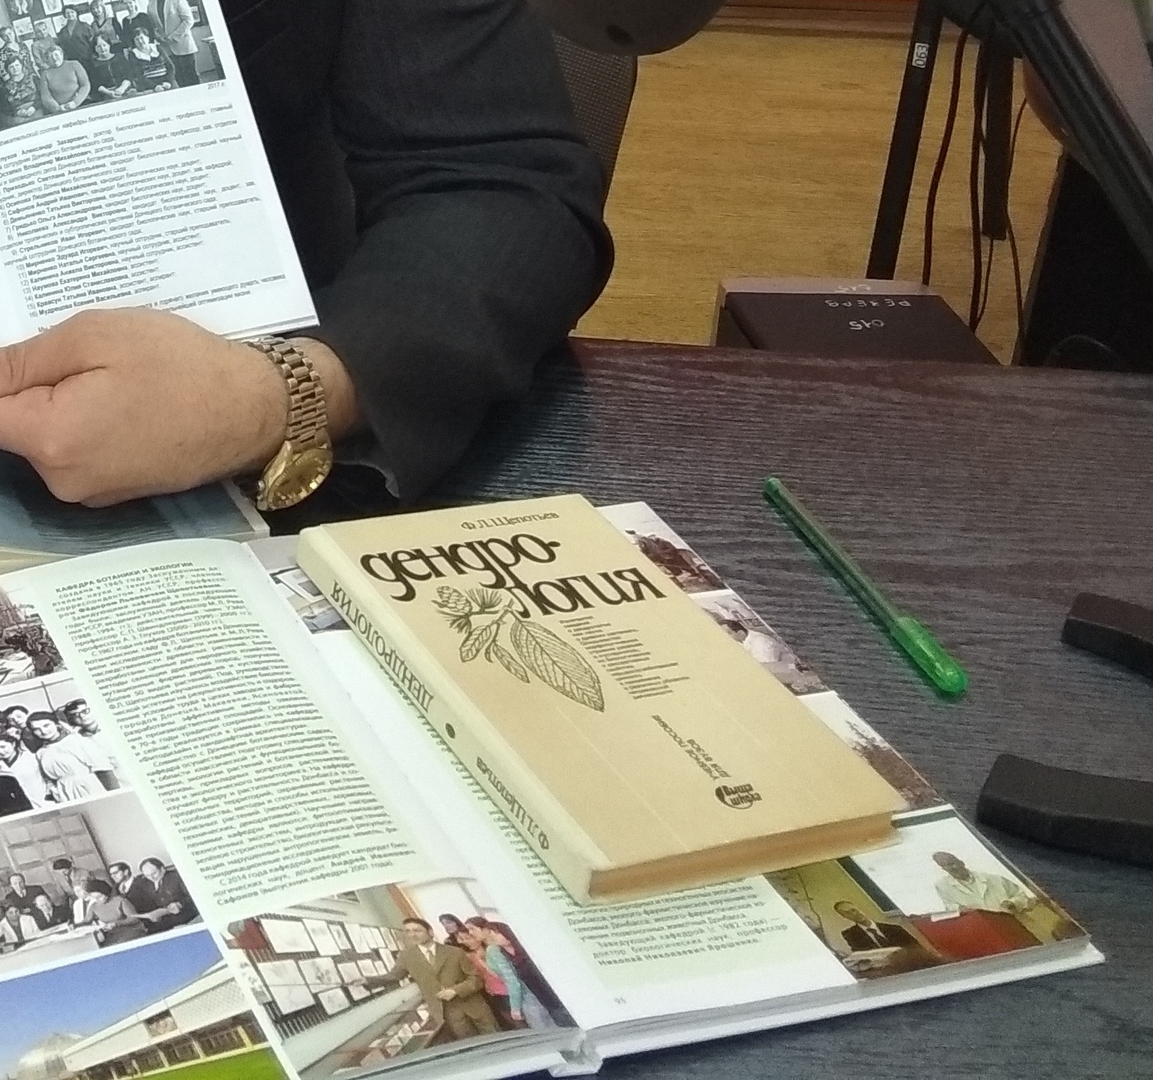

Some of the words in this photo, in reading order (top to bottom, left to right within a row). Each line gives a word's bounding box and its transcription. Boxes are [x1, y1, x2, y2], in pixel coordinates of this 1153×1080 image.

[914, 45, 927, 67] 063
[22, 143, 53, 155] Александр
[55, 580, 95, 593] КАФЕДРА
[96, 570, 141, 583] БОТАНИКИ
[150, 562, 193, 572] ЭКОЛОГИИ
[104, 580, 123, 588] 1965
[504, 568, 668, 619] логия
[330, 580, 434, 712] ДЕНДРОЛОГИЯ
[651, 714, 687, 748] ПОСОБИЕ
[686, 738, 714, 763] ВУЗОВ
[228, 874, 247, 884] 2014
[268, 858, 312, 873] кафедрой
[331, 856, 366, 867] Андрей
[370, 850, 416, 860] Иванович
[217, 891, 259, 906] Сафонов
